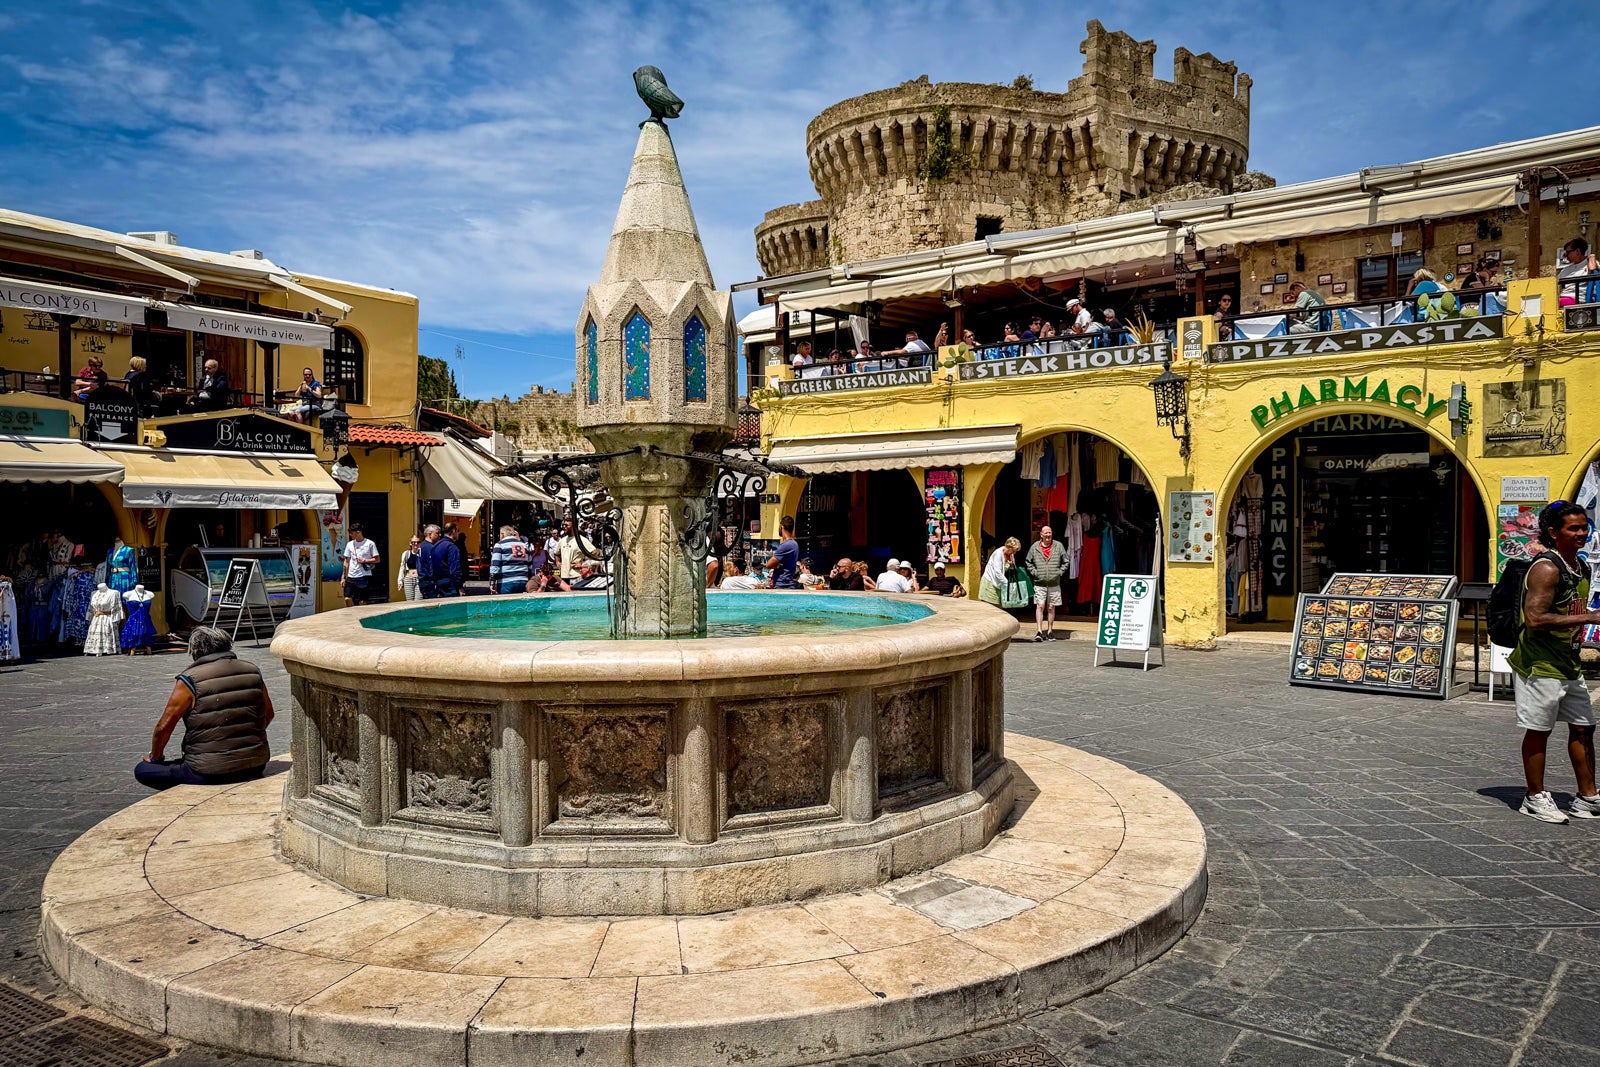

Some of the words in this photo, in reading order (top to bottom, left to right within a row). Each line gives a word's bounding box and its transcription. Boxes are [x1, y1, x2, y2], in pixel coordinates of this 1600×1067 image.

[199, 318, 207, 327] A
[211, 319, 240, 333] Drink
[244, 325, 268, 337] with
[278, 331, 305, 342] view.
[1232, 321, 1496, 360] PIZZA-PASTA
[975, 357, 1059, 379] STEAK
[1066, 345, 1168, 370] HOUSE
[791, 381, 832, 394] GREEK
[836, 370, 930, 390] RESTAURANT
[89, 402, 134, 414] BALCONY
[89, 412, 134, 421] ENTRANCE
[1251, 376, 1449, 428] PHARMACY
[1271, 448, 1287, 586] PHARMACY
[1103, 579, 1122, 644] PHARMACY
